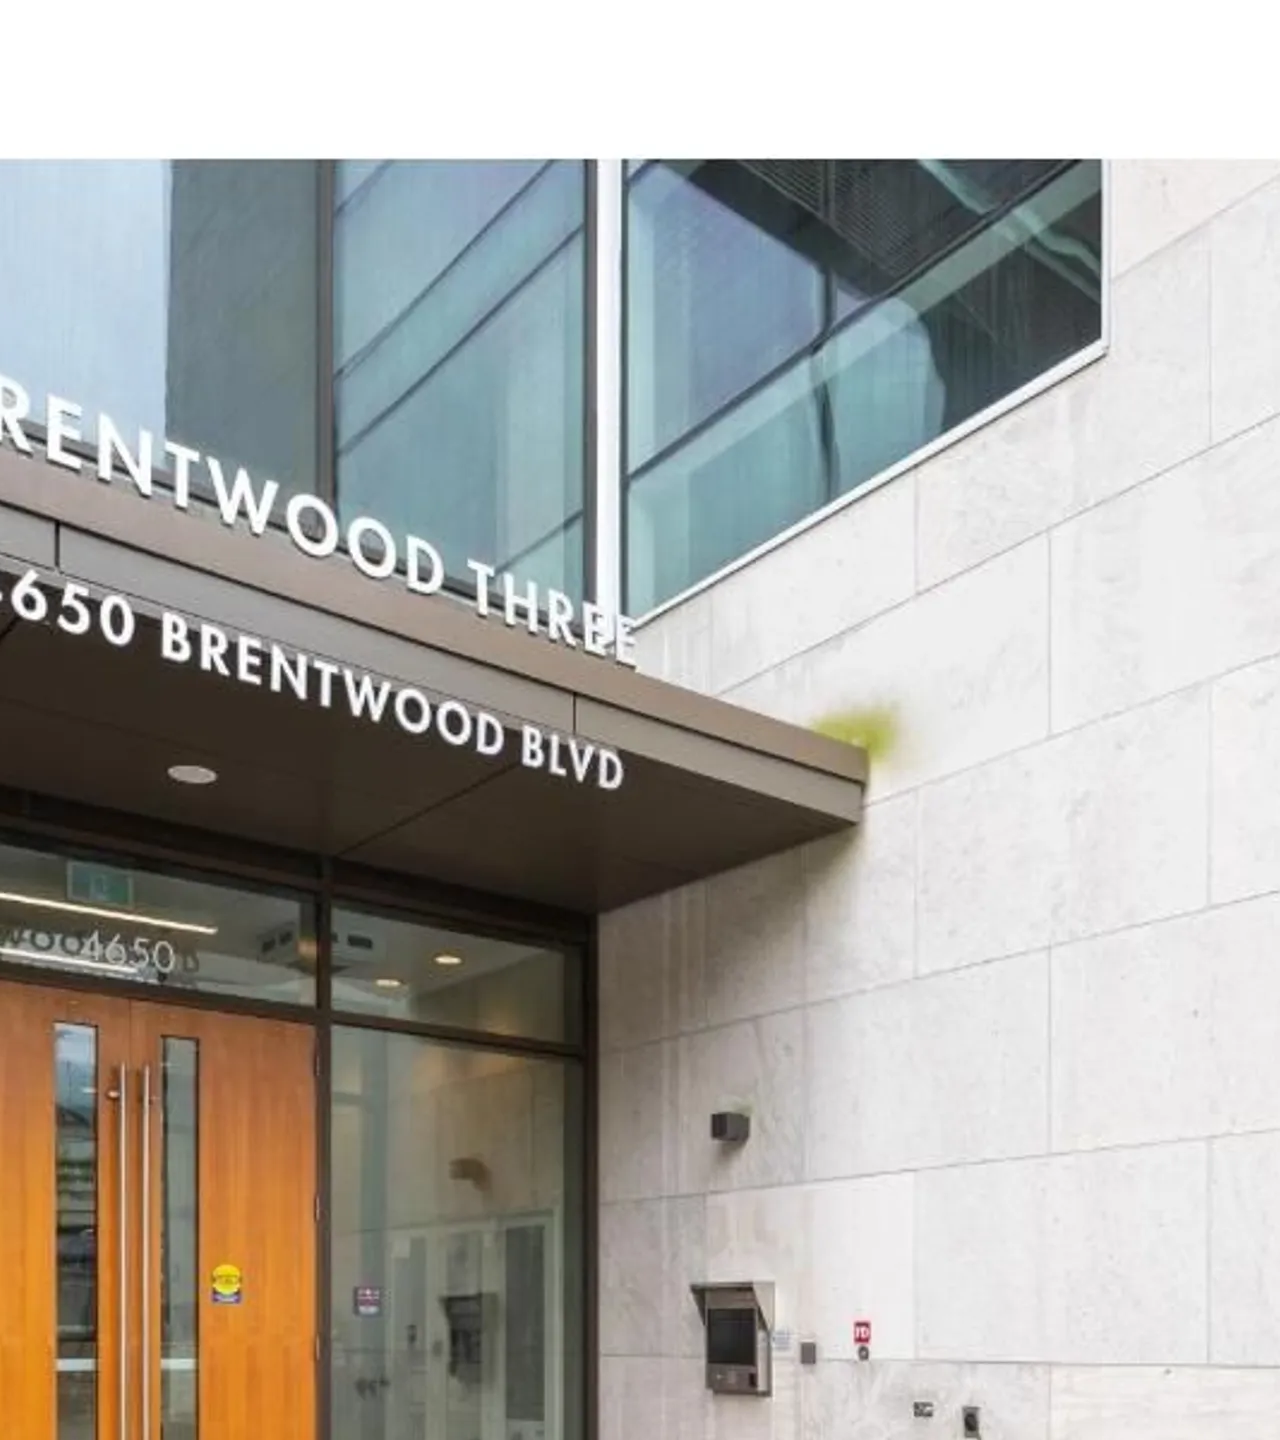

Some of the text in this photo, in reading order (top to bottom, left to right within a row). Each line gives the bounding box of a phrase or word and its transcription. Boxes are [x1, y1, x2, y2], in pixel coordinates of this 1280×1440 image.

[466, 560, 638, 668] THREE
[160, 612, 506, 756] BRENTWOOD
[521, 725, 624, 792] BLVD
[84, 928, 176, 973] 4650
